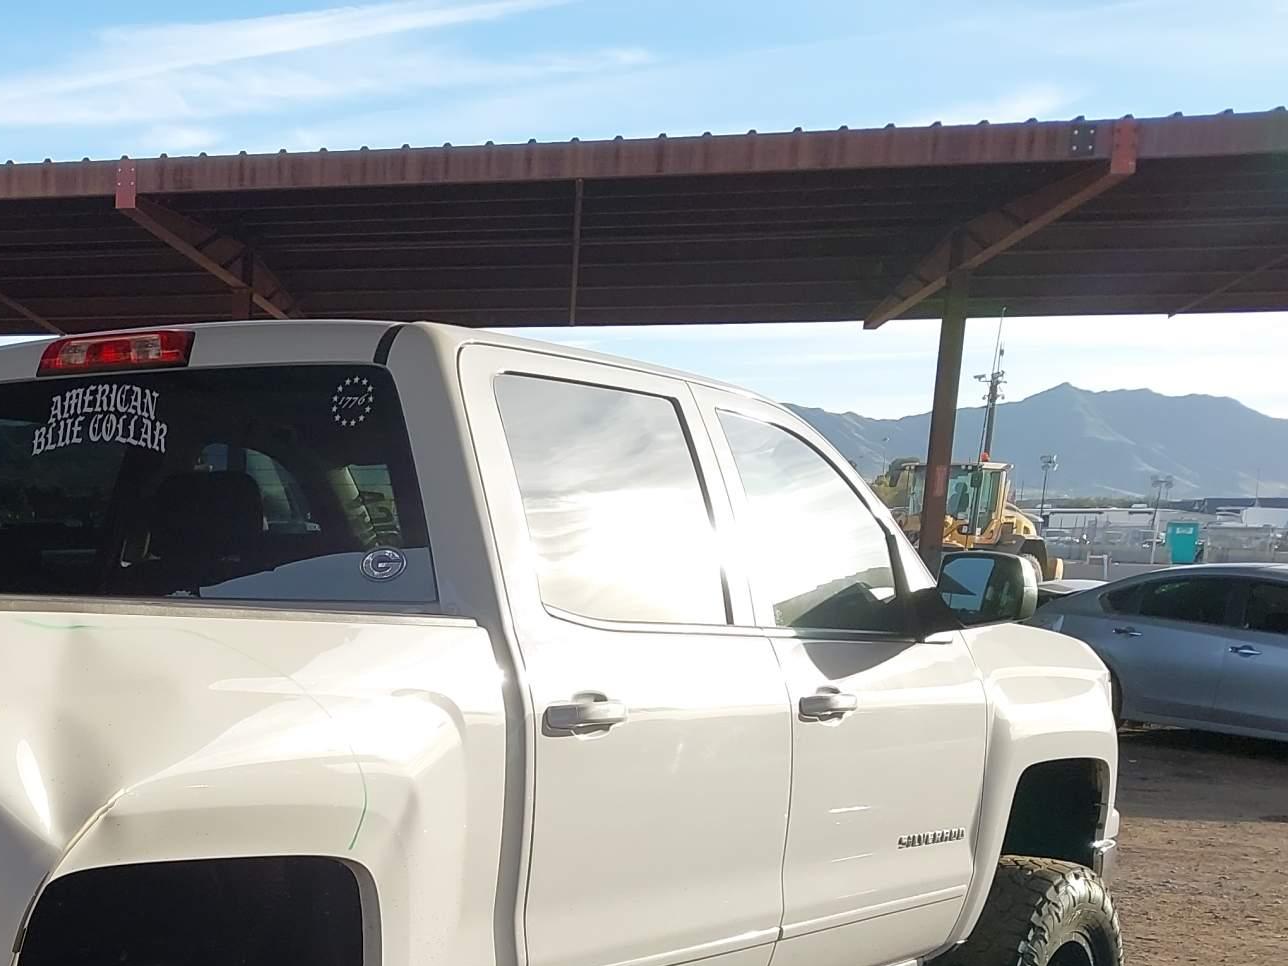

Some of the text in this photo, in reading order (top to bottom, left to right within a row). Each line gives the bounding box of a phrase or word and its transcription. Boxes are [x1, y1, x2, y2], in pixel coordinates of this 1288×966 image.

[48, 384, 160, 424] AMERICAN
[338, 393, 370, 408] 1776
[32, 413, 168, 456] BLUE COLLAR
[896, 826, 966, 850] SILVERADO
